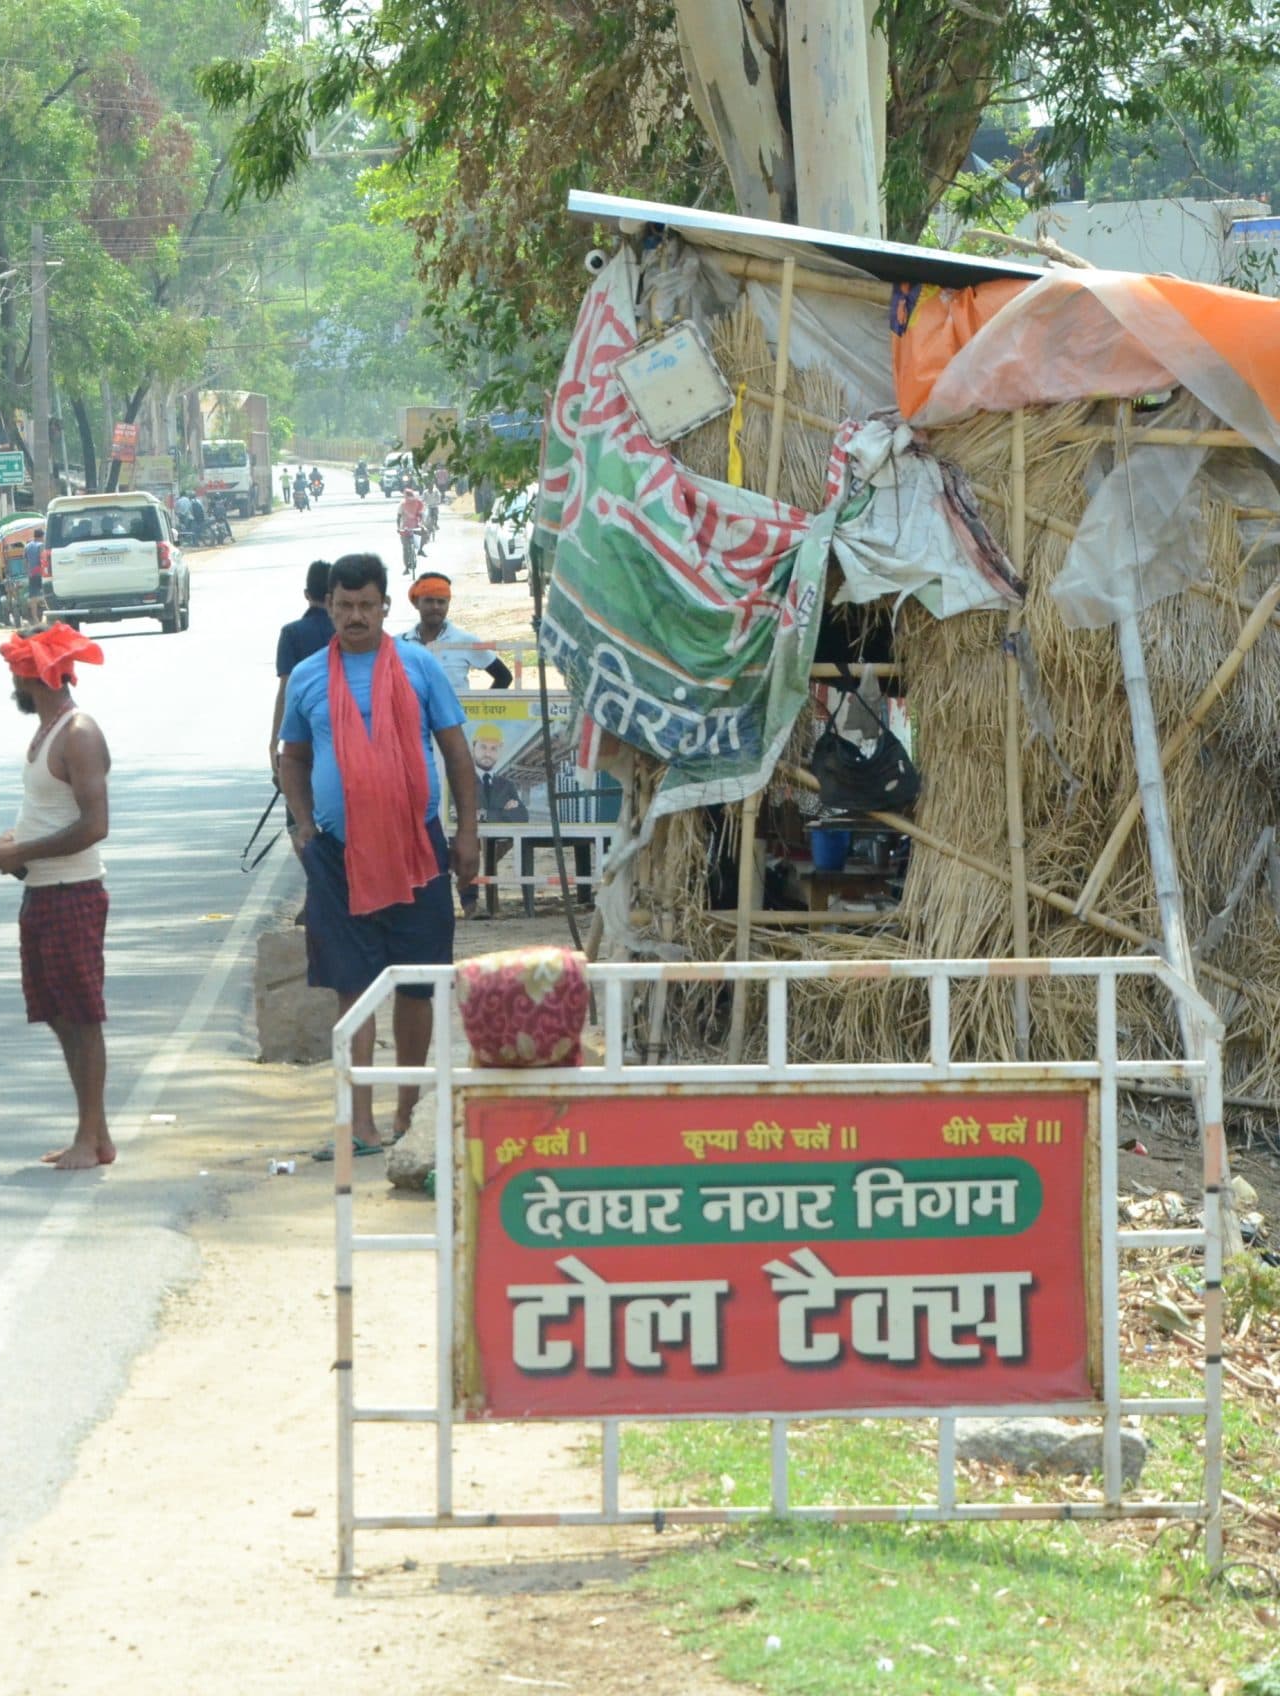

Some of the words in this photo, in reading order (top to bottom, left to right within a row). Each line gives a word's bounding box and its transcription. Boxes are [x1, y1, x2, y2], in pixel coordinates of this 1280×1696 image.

[582, 642, 742, 760] तिरंगा
[532, 1127, 570, 1155] चलें
[745, 1120, 784, 1150] धीरे
[790, 1120, 832, 1150] चलें
[942, 1115, 980, 1145] धीरे
[986, 1114, 1028, 1145] चलें
[523, 1176, 683, 1239] देवघर
[699, 1184, 835, 1232] नगर
[852, 1167, 1018, 1229] निगम
[507, 1255, 729, 1370] टोल
[761, 1246, 1033, 1365] टैक्स
